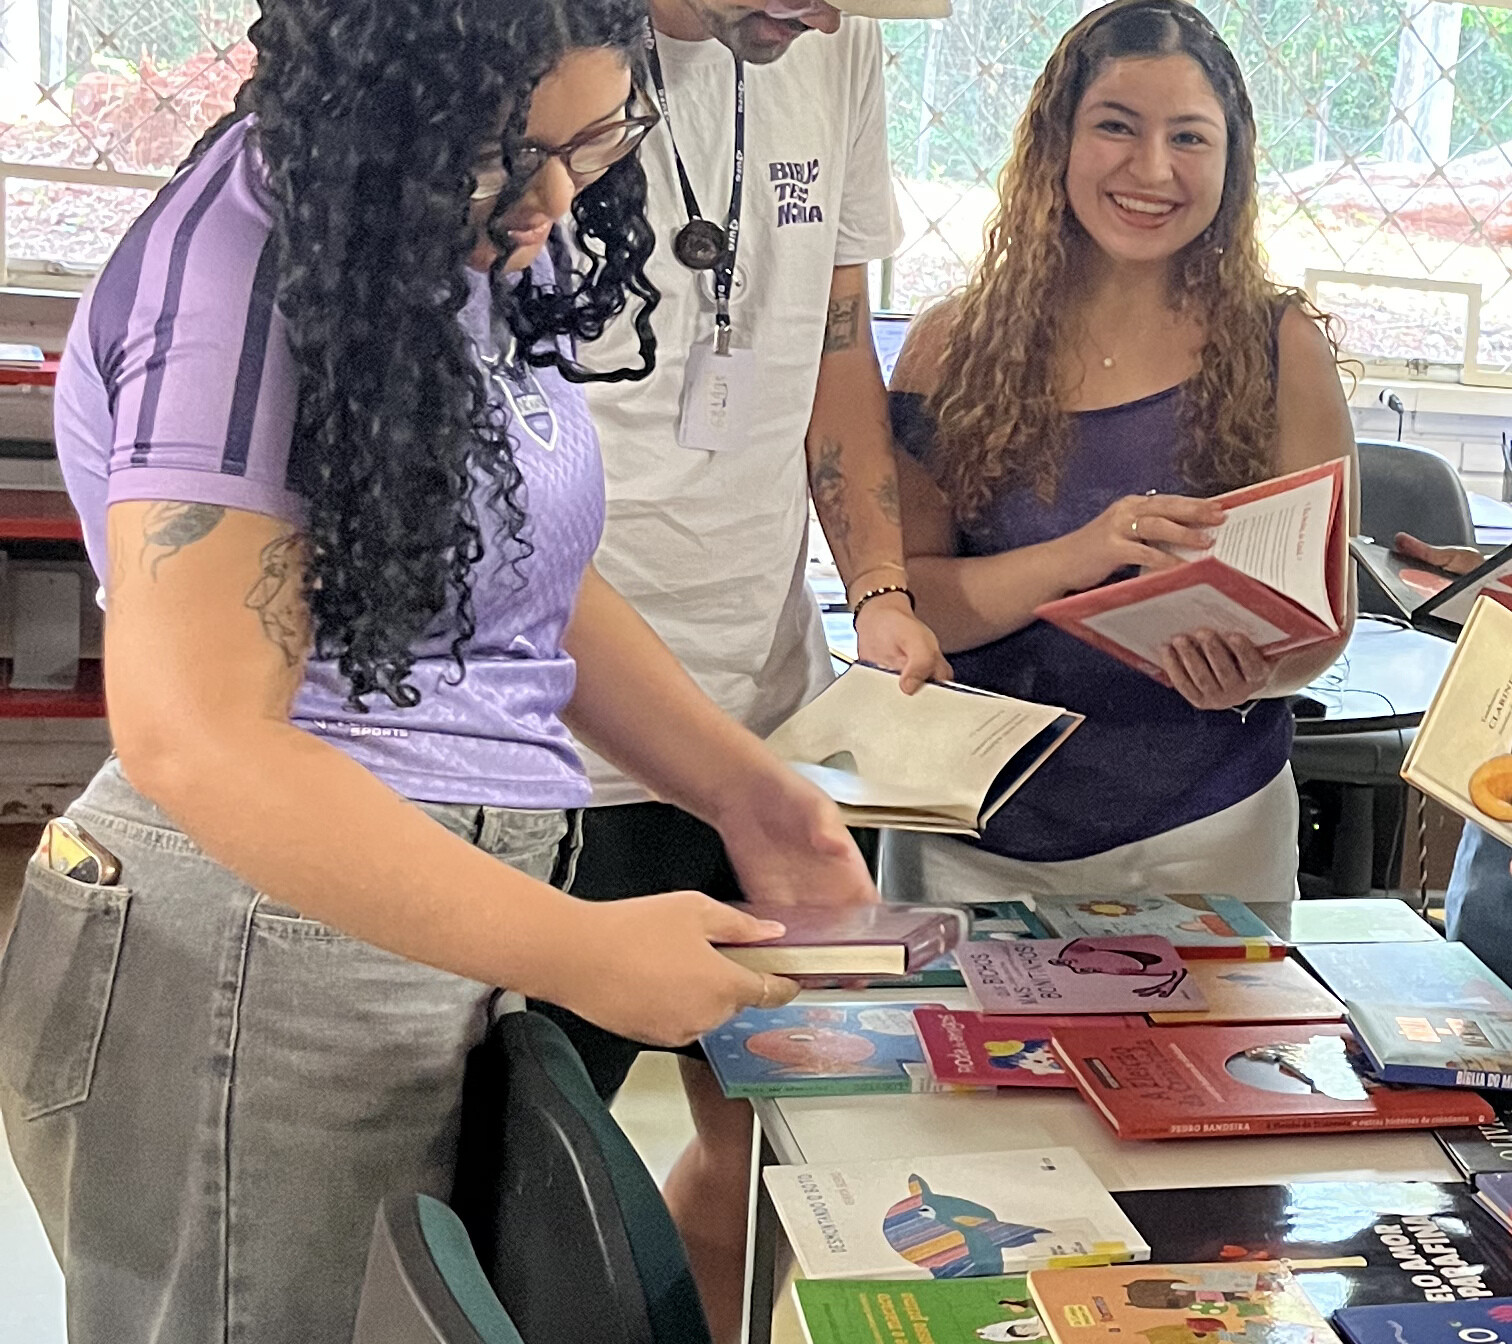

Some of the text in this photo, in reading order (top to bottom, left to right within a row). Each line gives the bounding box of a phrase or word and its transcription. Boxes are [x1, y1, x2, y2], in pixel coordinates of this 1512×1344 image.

[350, 728, 408, 736] SPORTS
[1374, 1224, 1455, 1302] ELO AMOR
[1401, 1216, 1493, 1297] PARAFINA
